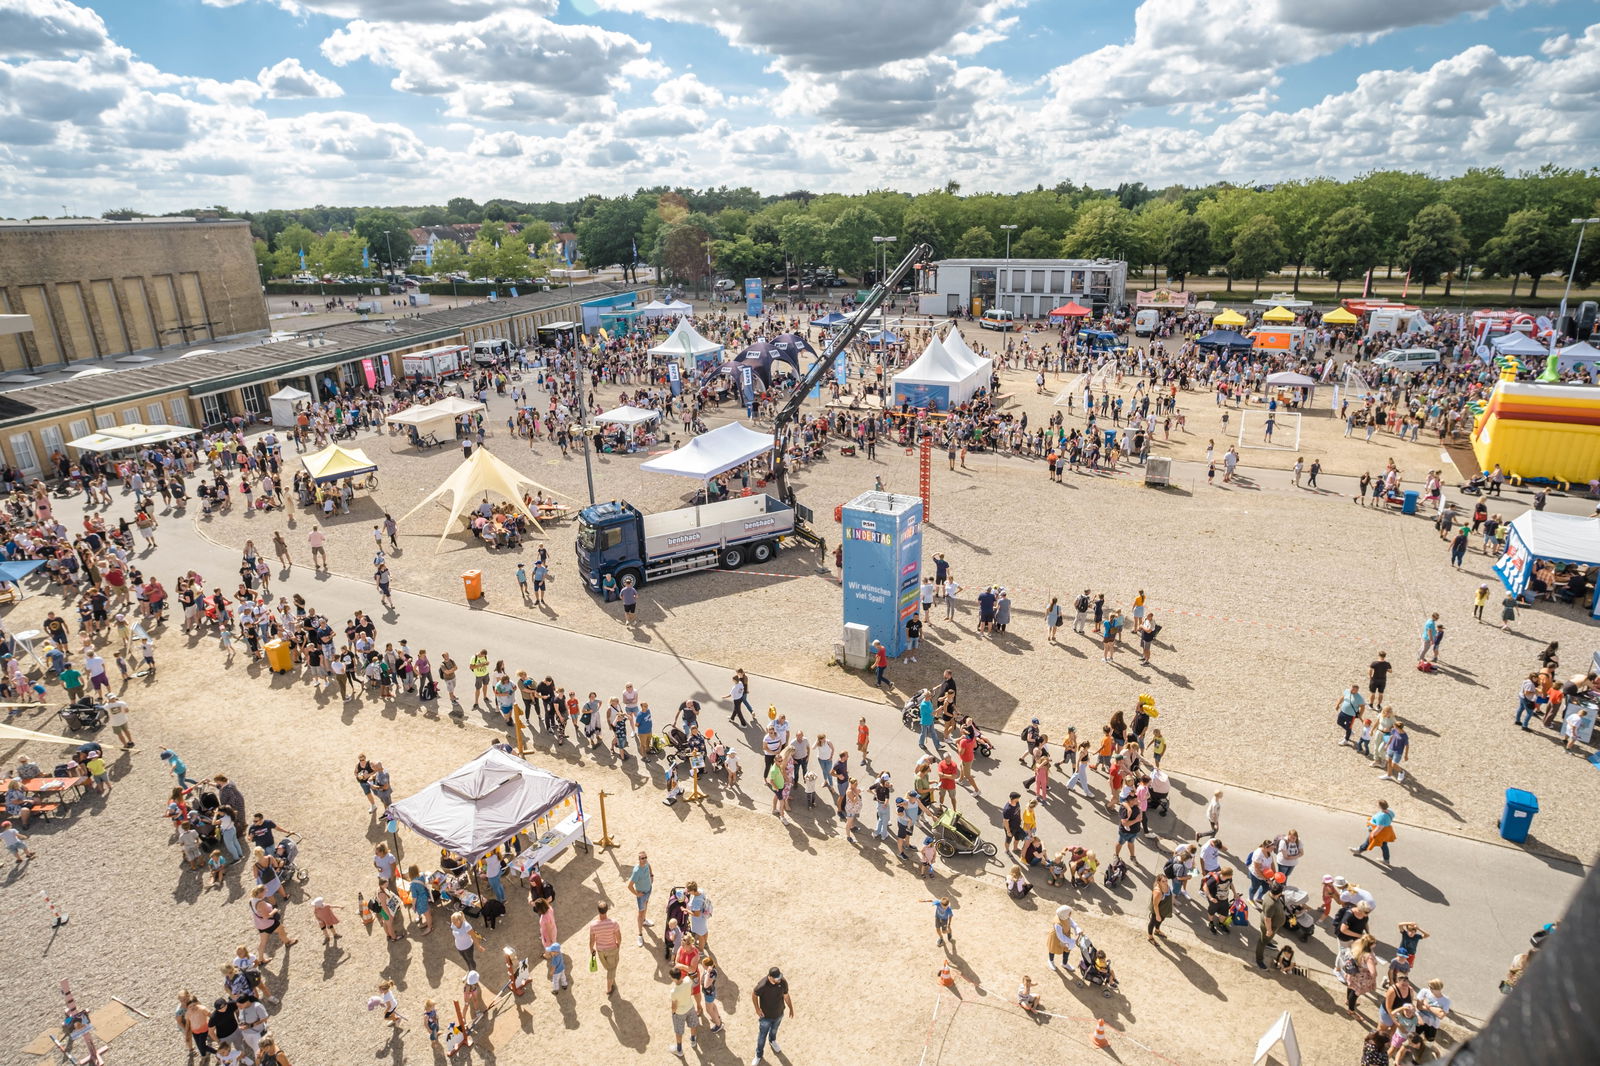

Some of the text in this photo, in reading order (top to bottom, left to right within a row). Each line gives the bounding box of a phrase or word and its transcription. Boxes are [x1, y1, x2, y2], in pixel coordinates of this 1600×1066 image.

[744, 518, 775, 529] benthack
[667, 533, 701, 545] benthack
[846, 528, 891, 545] KINDERTAG
[848, 581, 860, 590] Wir
[861, 583, 891, 597] wünschen
[855, 592, 867, 600] viel
